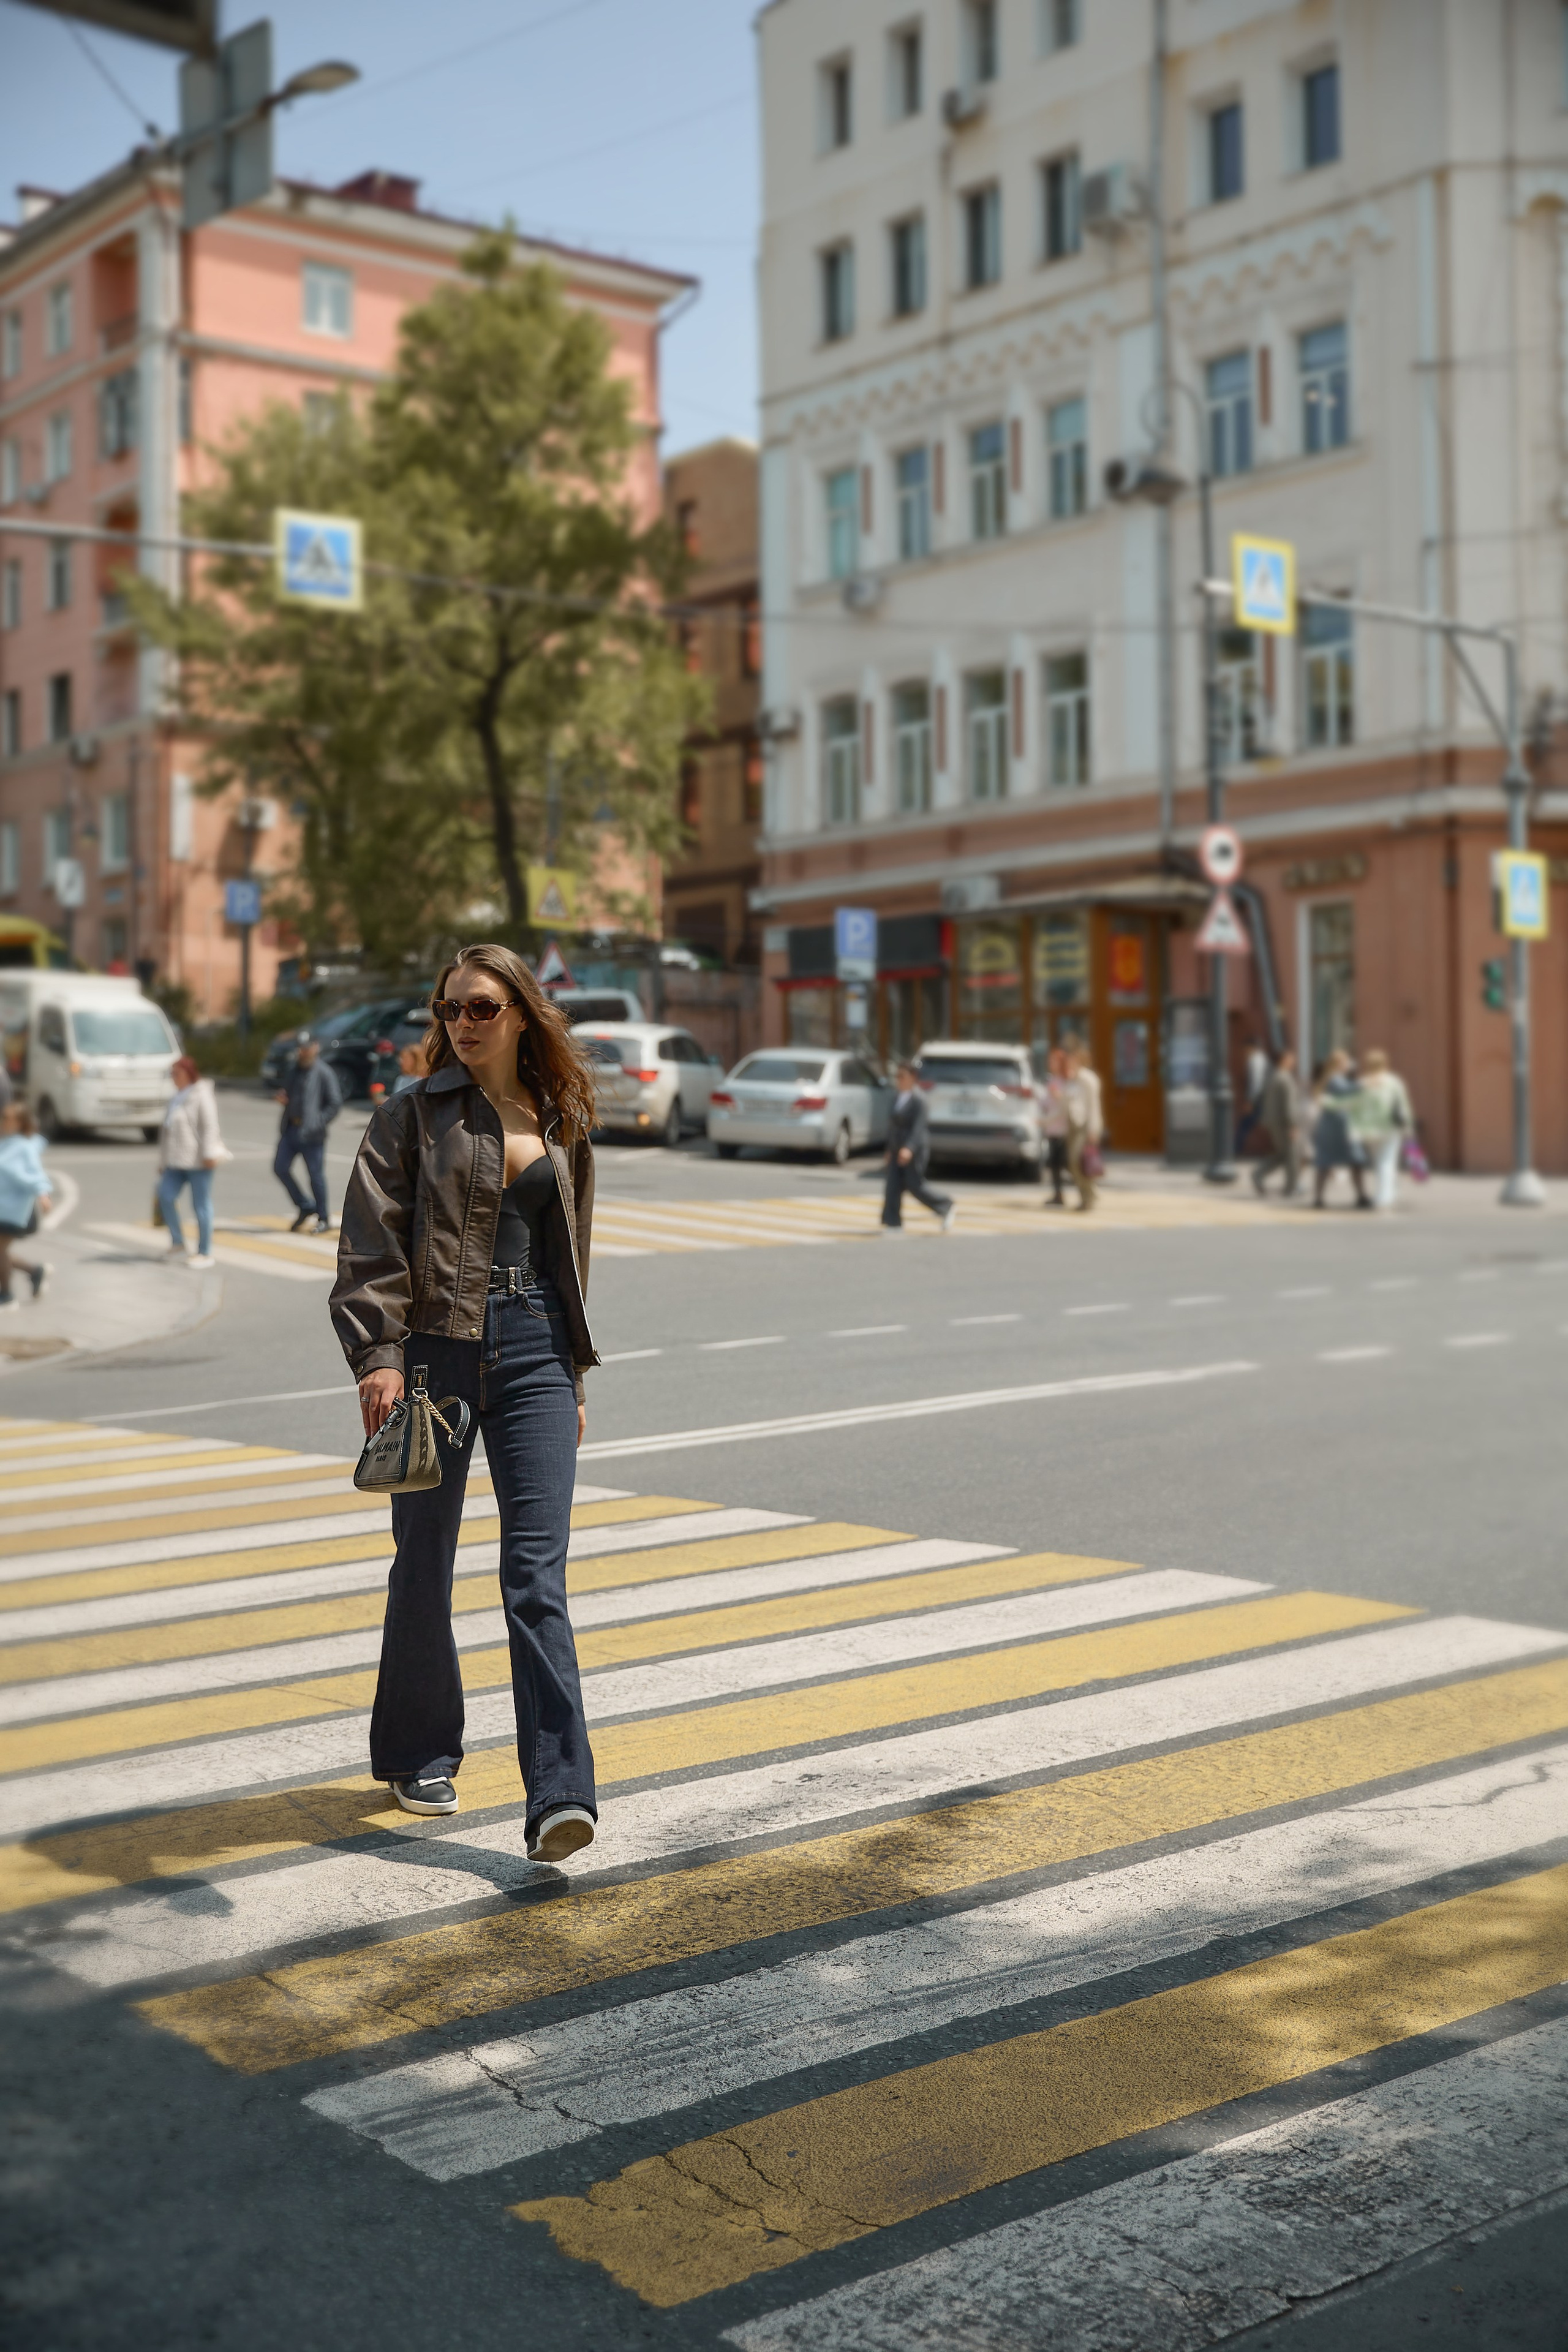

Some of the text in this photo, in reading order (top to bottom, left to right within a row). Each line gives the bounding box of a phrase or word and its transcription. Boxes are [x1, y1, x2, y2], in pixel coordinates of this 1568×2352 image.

[235, 886, 255, 918] P
[846, 914, 869, 951] P
[374, 1441, 401, 1455] BALMAIN
